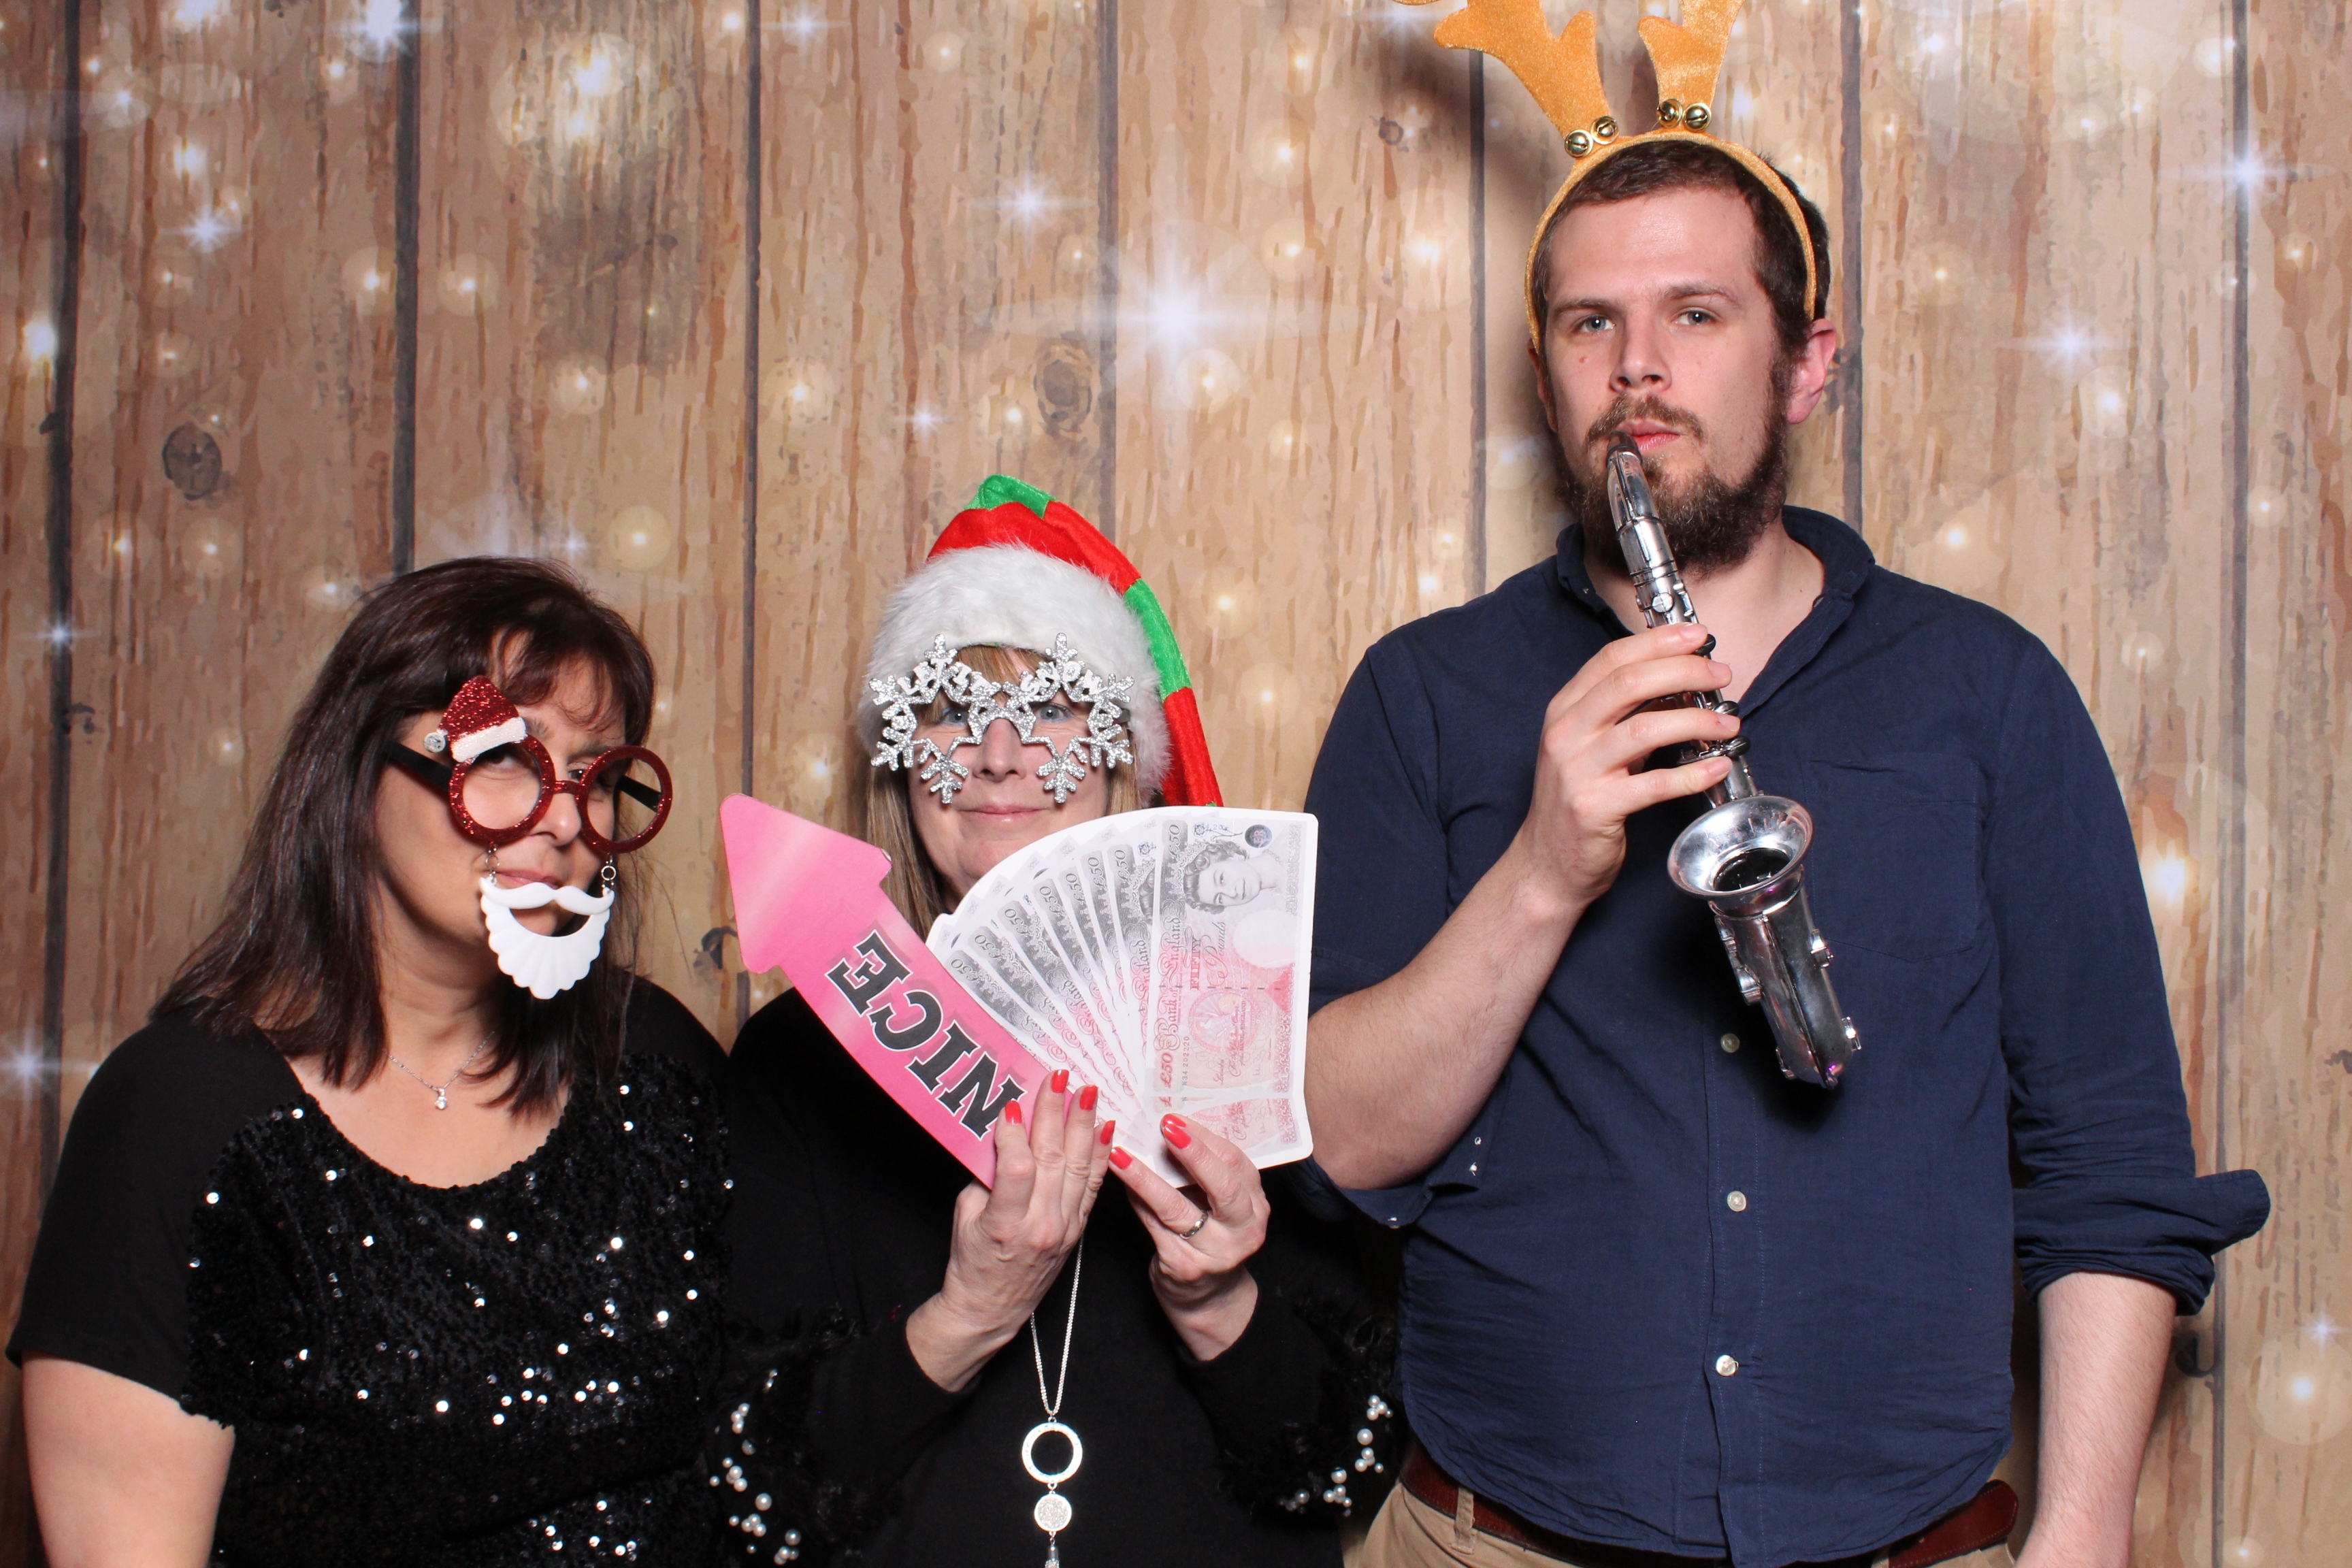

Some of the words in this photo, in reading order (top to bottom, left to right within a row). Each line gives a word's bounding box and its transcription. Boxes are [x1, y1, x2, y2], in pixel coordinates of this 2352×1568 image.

[896, 658, 953, 696] LET
[953, 662, 998, 693] IT
[1020, 660, 1109, 697] SNOW
[1168, 824, 1181, 859] £50
[1088, 857, 1107, 890] £50
[1114, 850, 1131, 883] £50
[1039, 886, 1064, 917] £50
[1065, 873, 1086, 905] £50
[1004, 909, 1030, 936] £50
[974, 934, 1002, 960] £50
[1158, 917, 1184, 985] England
[1190, 936, 1200, 990] FIFTY
[1201, 921, 1228, 987] Pounds
[951, 958, 980, 984] £50
[824, 929, 1028, 1141] NICE
[1154, 998, 1179, 1050] Bank
[1160, 1053, 1173, 1088] £50
